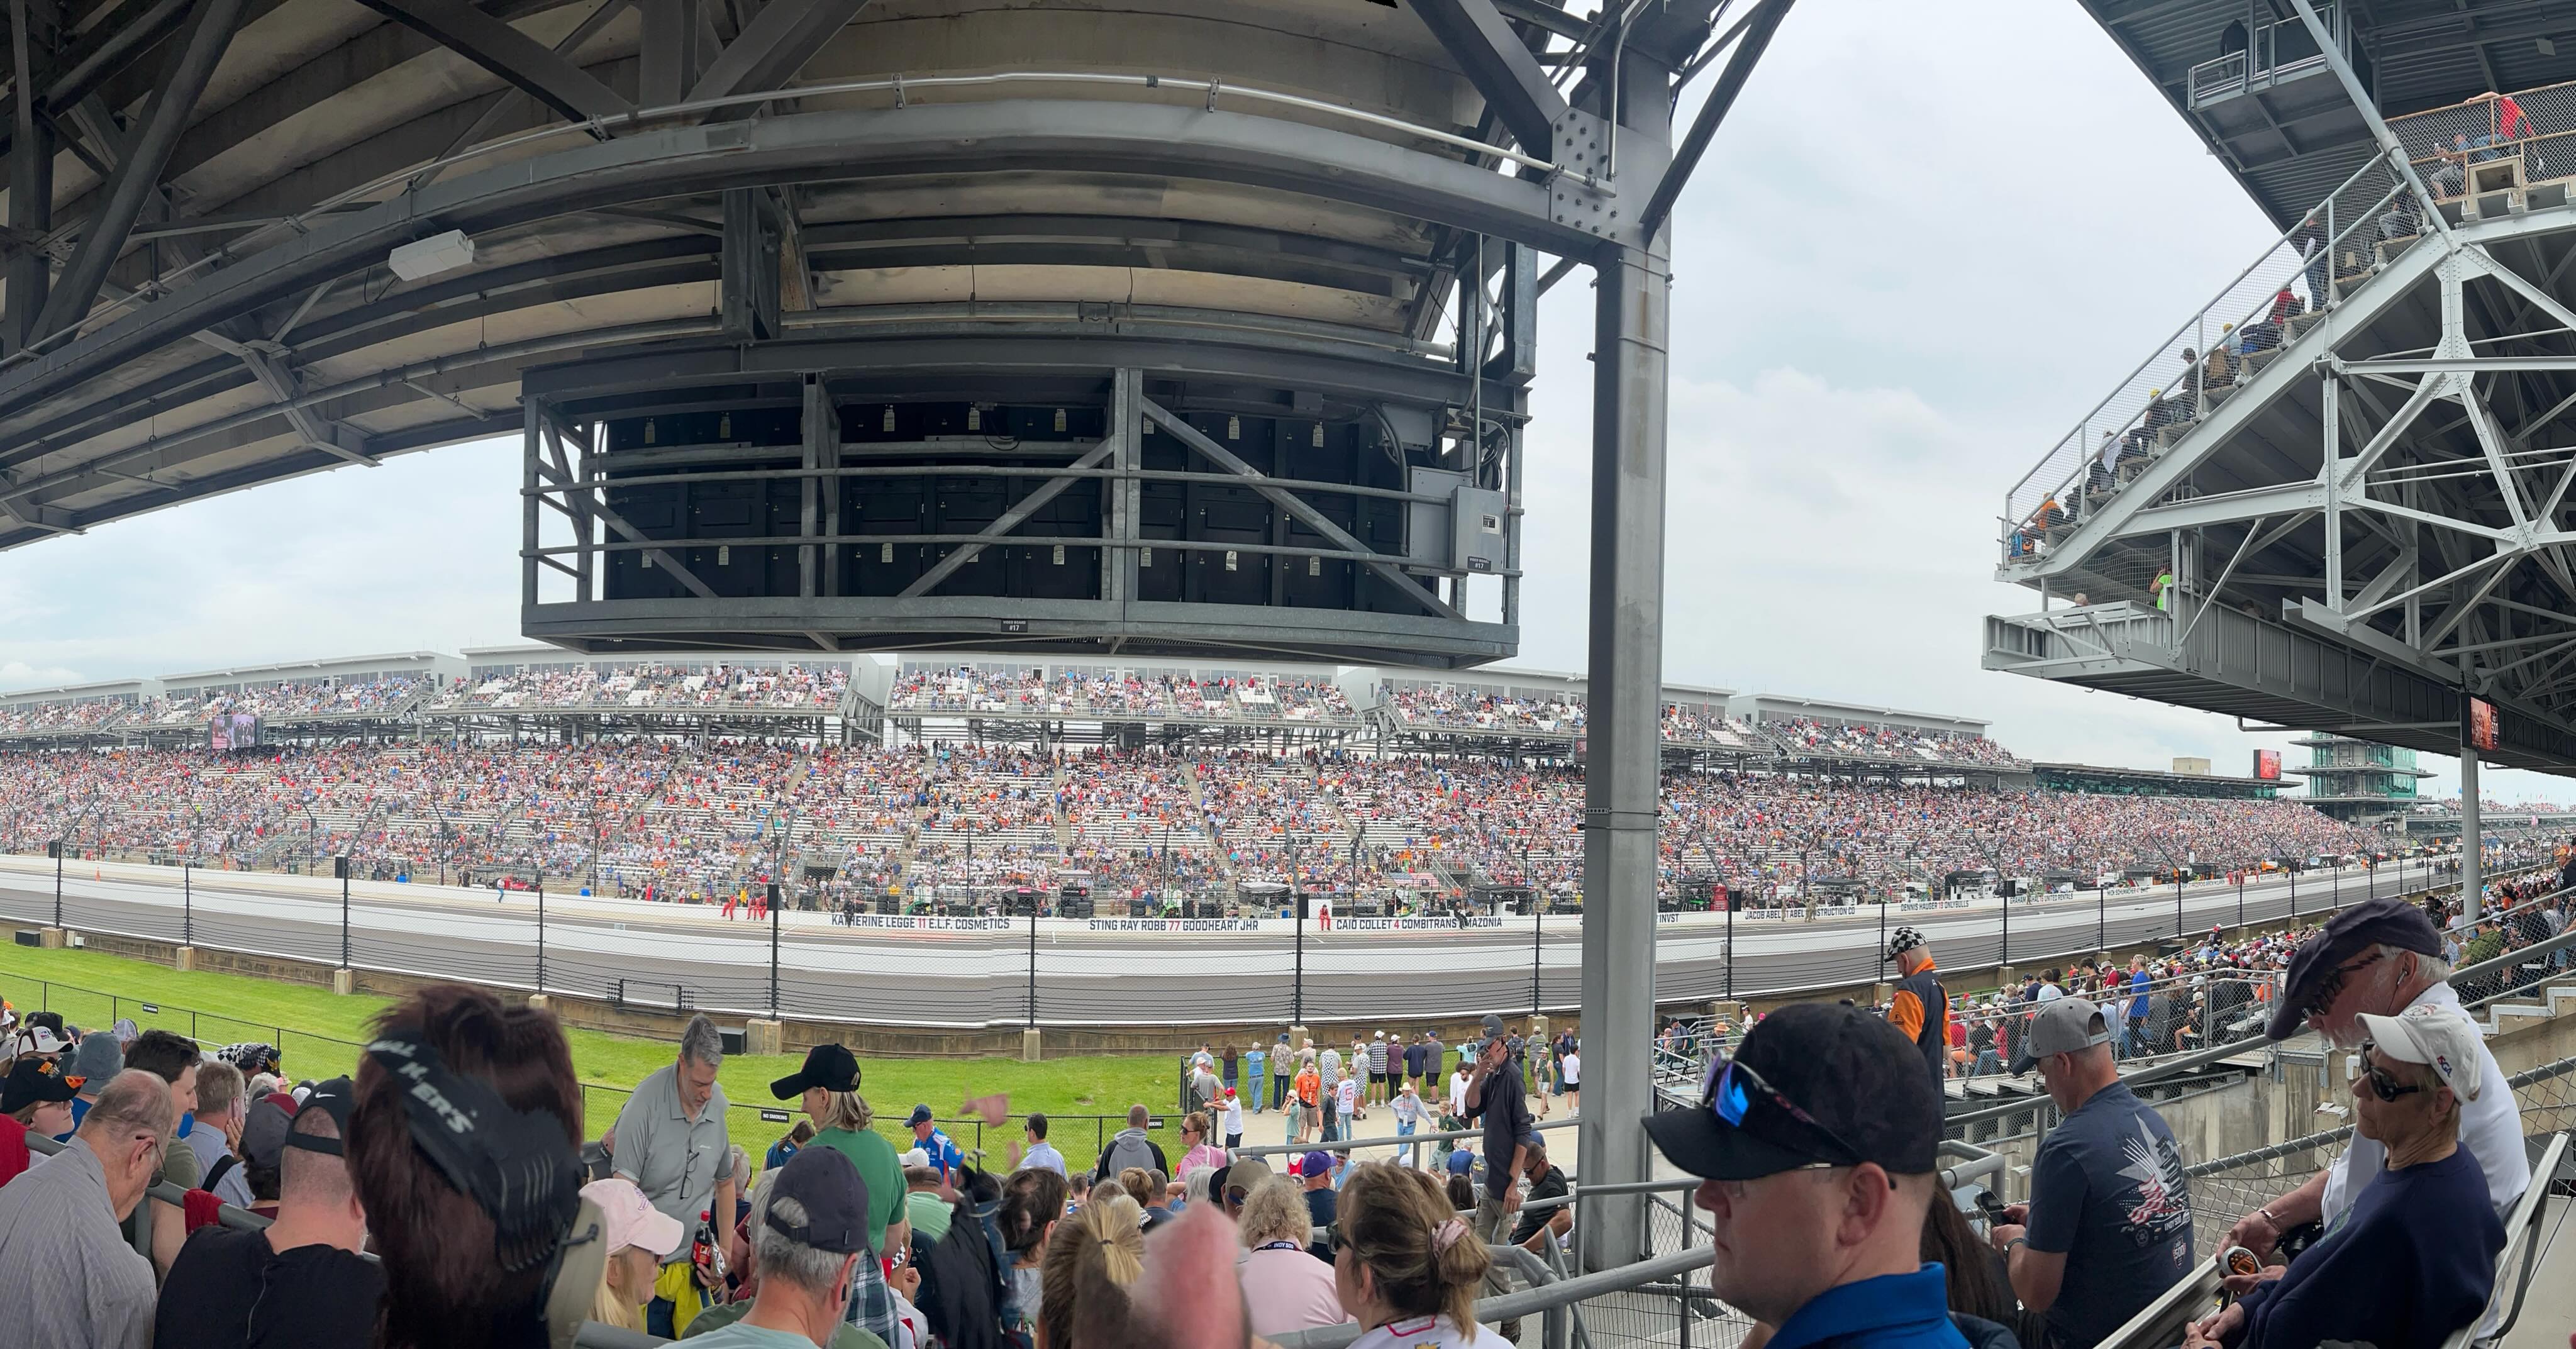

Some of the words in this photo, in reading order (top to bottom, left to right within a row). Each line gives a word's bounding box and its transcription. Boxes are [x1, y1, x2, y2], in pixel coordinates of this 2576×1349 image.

[1901, 903, 1918, 911] DENNIS
[1919, 902, 1937, 910] HAUGER
[1945, 900, 1969, 909] ONLYBULLS
[2010, 896, 2026, 904] GRAHAM
[1660, 913, 1679, 923] INVST
[1745, 911, 1765, 919] JACOB
[1766, 910, 1781, 919] ABEL
[1790, 909, 1804, 918] ABEL
[1848, 906, 1855, 914] CO
[886, 917, 915, 928] LEGGE
[918, 918, 926, 928] 11
[929, 918, 953, 930] E.L.F.
[955, 918, 1010, 930] COSMETICS
[1090, 919, 1118, 930] STING
[1120, 920, 1139, 931] RAY
[1141, 920, 1166, 931] ROBB
[1169, 921, 1180, 931] 77
[1183, 920, 1239, 931] GOODHEART
[1240, 920, 1258, 931] JHR
[1336, 919, 1357, 930] CAIO
[1359, 919, 1392, 930] COLLET
[1394, 919, 1399, 930] 4
[1402, 918, 1457, 929] COMBITRANS
[1345, 1087, 1353, 1101] 5
